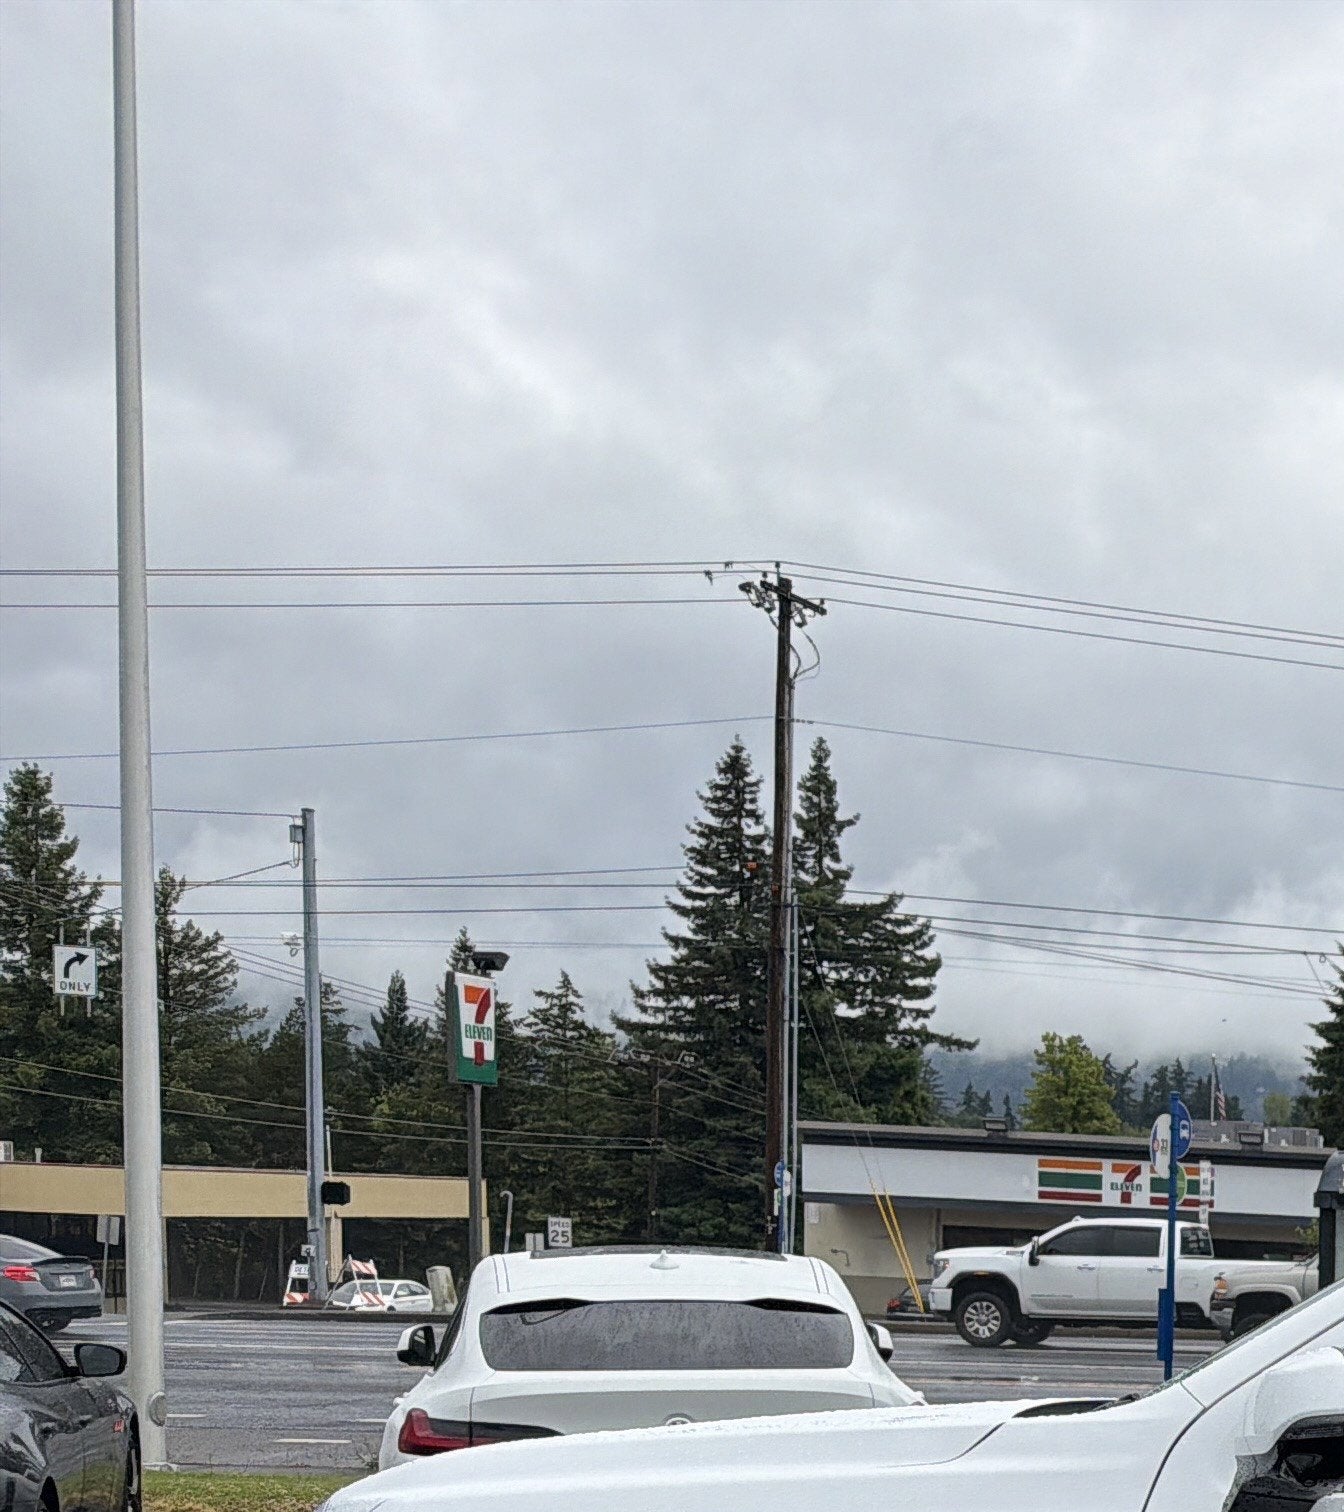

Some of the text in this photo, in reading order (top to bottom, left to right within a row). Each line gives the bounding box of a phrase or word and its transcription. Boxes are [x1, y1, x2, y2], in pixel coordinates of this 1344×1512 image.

[60, 981, 91, 992] ONLY
[464, 984, 492, 1067] 7
[1111, 1163, 1142, 1204] 7
[550, 1229, 570, 1244] 25
